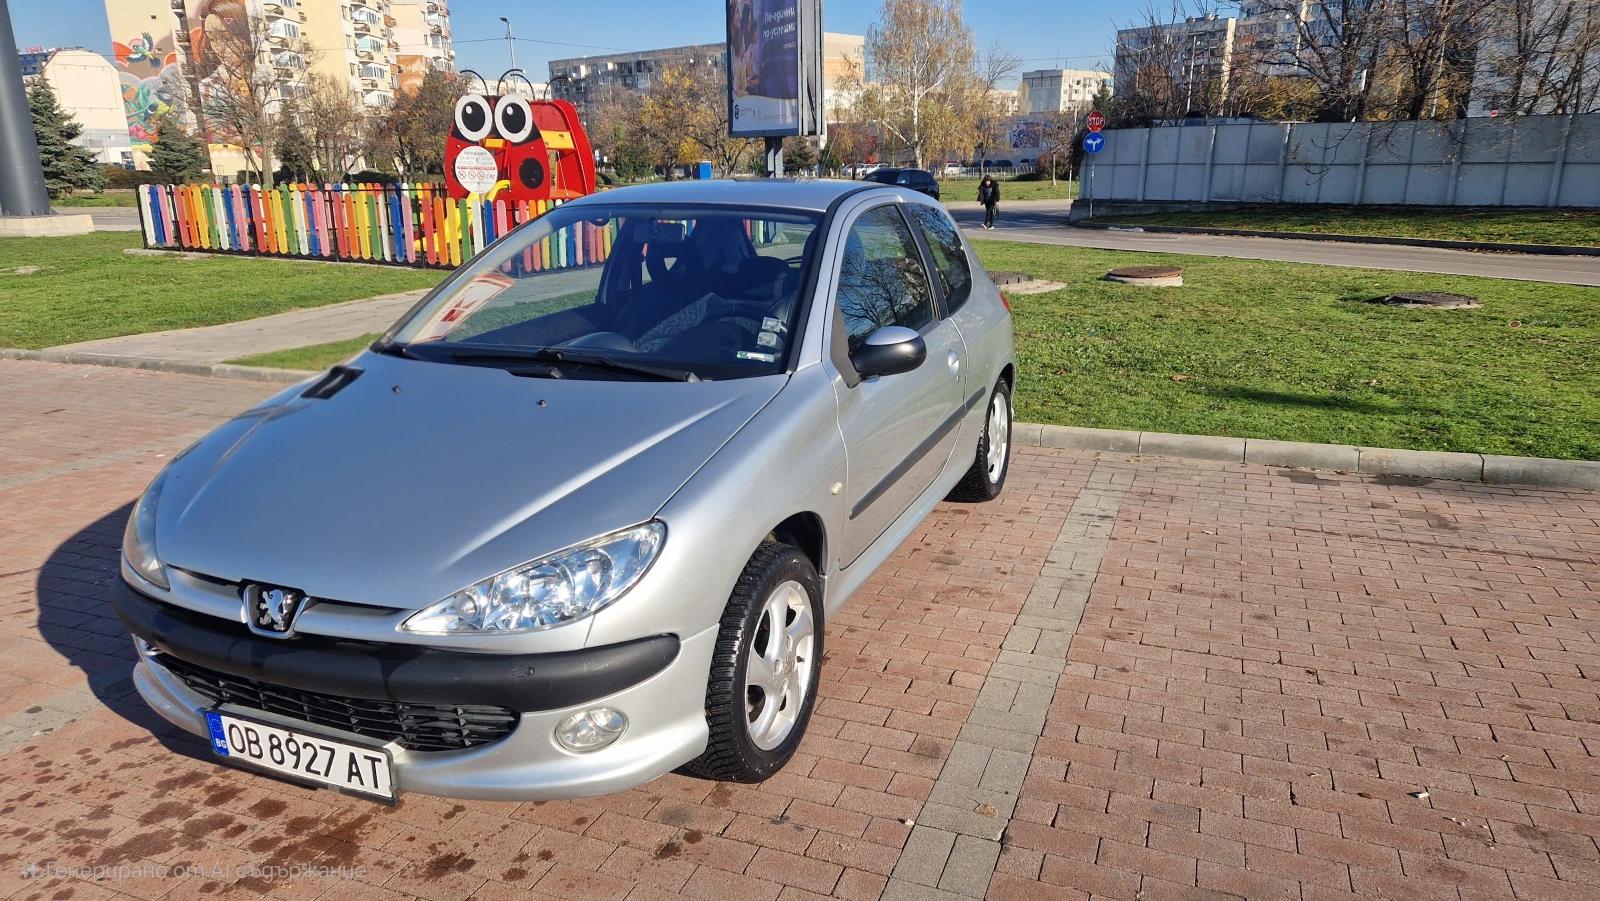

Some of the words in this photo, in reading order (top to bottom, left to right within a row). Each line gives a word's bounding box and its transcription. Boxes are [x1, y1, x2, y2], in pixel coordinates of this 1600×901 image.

[762, 23, 796, 39] по-успешни
[1089, 117, 1104, 125] STOP
[215, 738, 227, 749] BG
[228, 723, 264, 760] OB
[268, 733, 336, 778] 8927
[347, 751, 382, 789] AT
